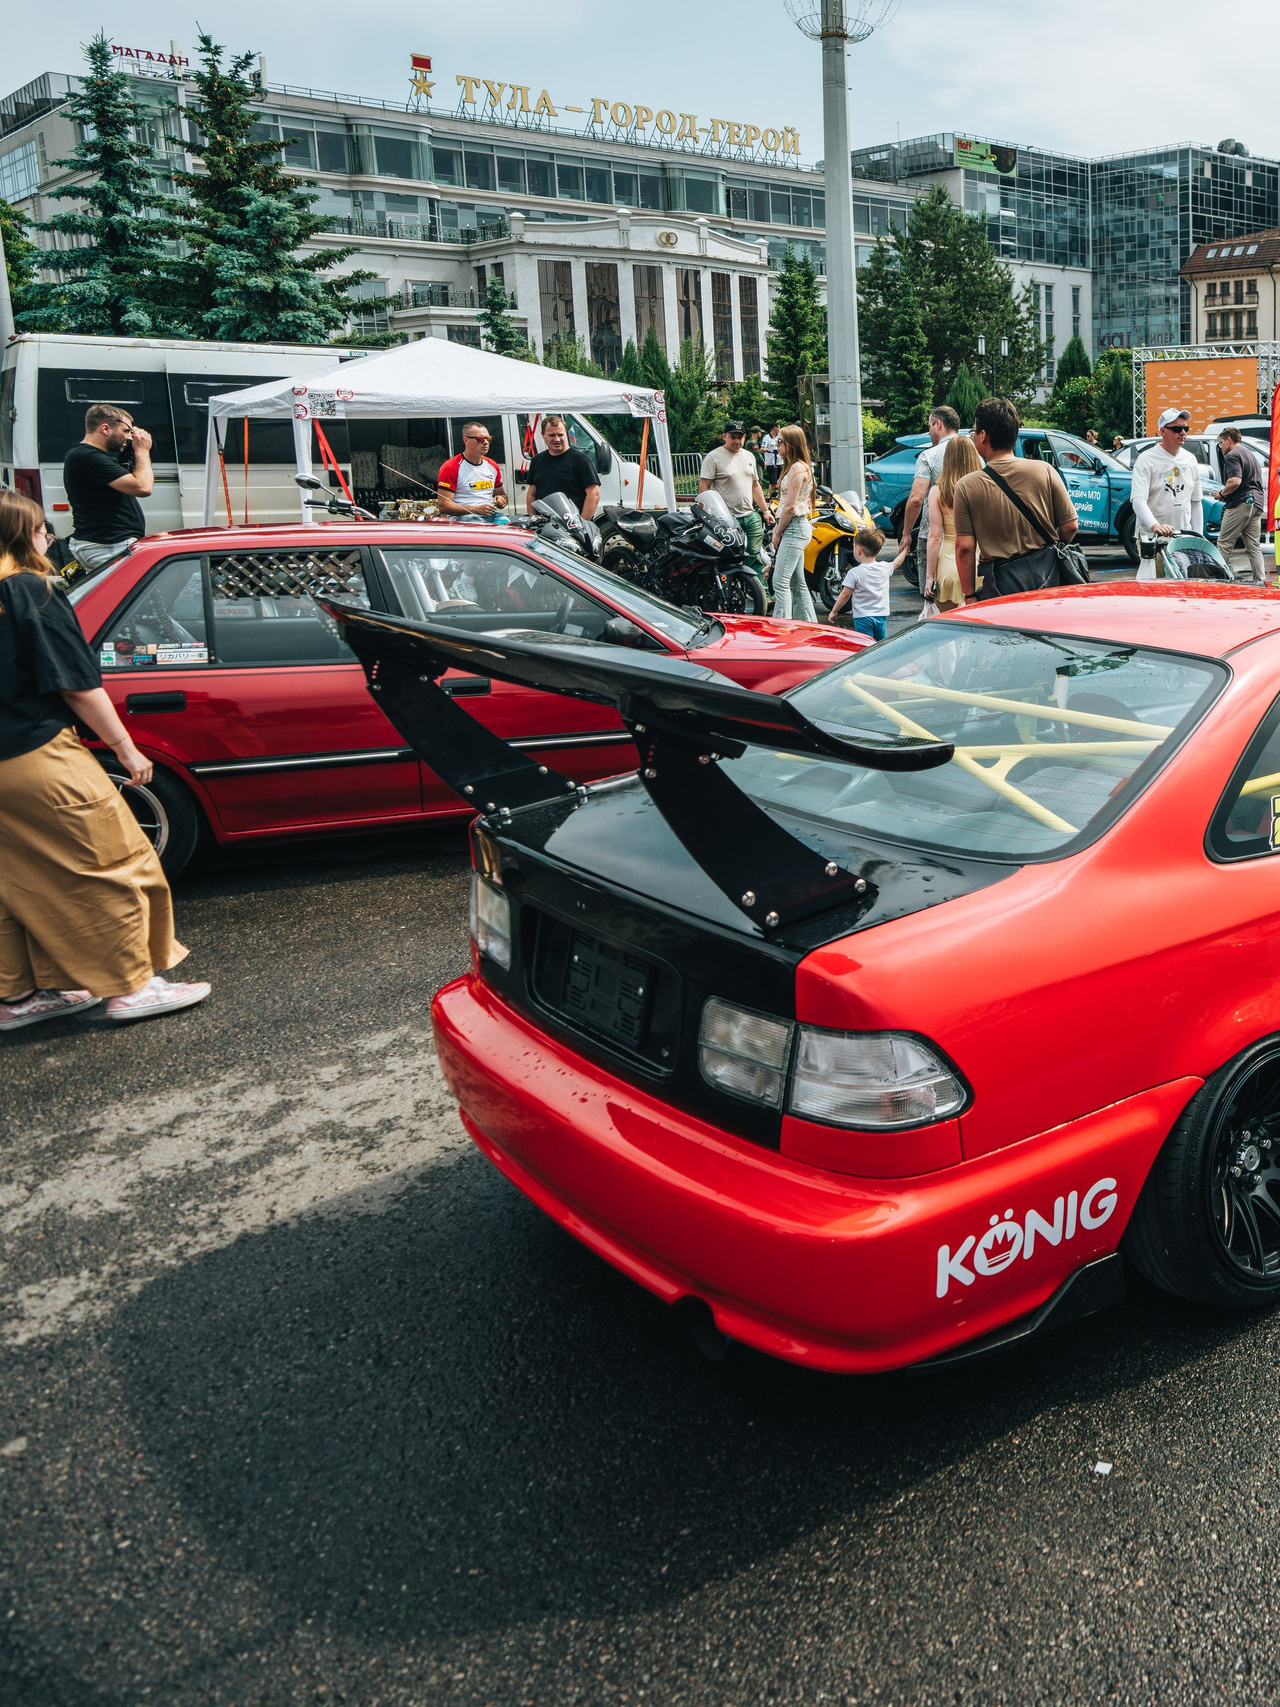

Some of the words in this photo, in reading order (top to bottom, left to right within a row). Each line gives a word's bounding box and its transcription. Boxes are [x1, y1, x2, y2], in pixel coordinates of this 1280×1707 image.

[111, 45, 189, 66] МАГАДАН
[456, 75, 558, 117] ТУЛА
[591, 98, 802, 156] ГОРОД-ГЕРОЙ
[957, 139, 972, 151] Hoff
[1067, 489, 1087, 499] СКВИЧ
[936, 1177, 1118, 1299] KÖNIG
